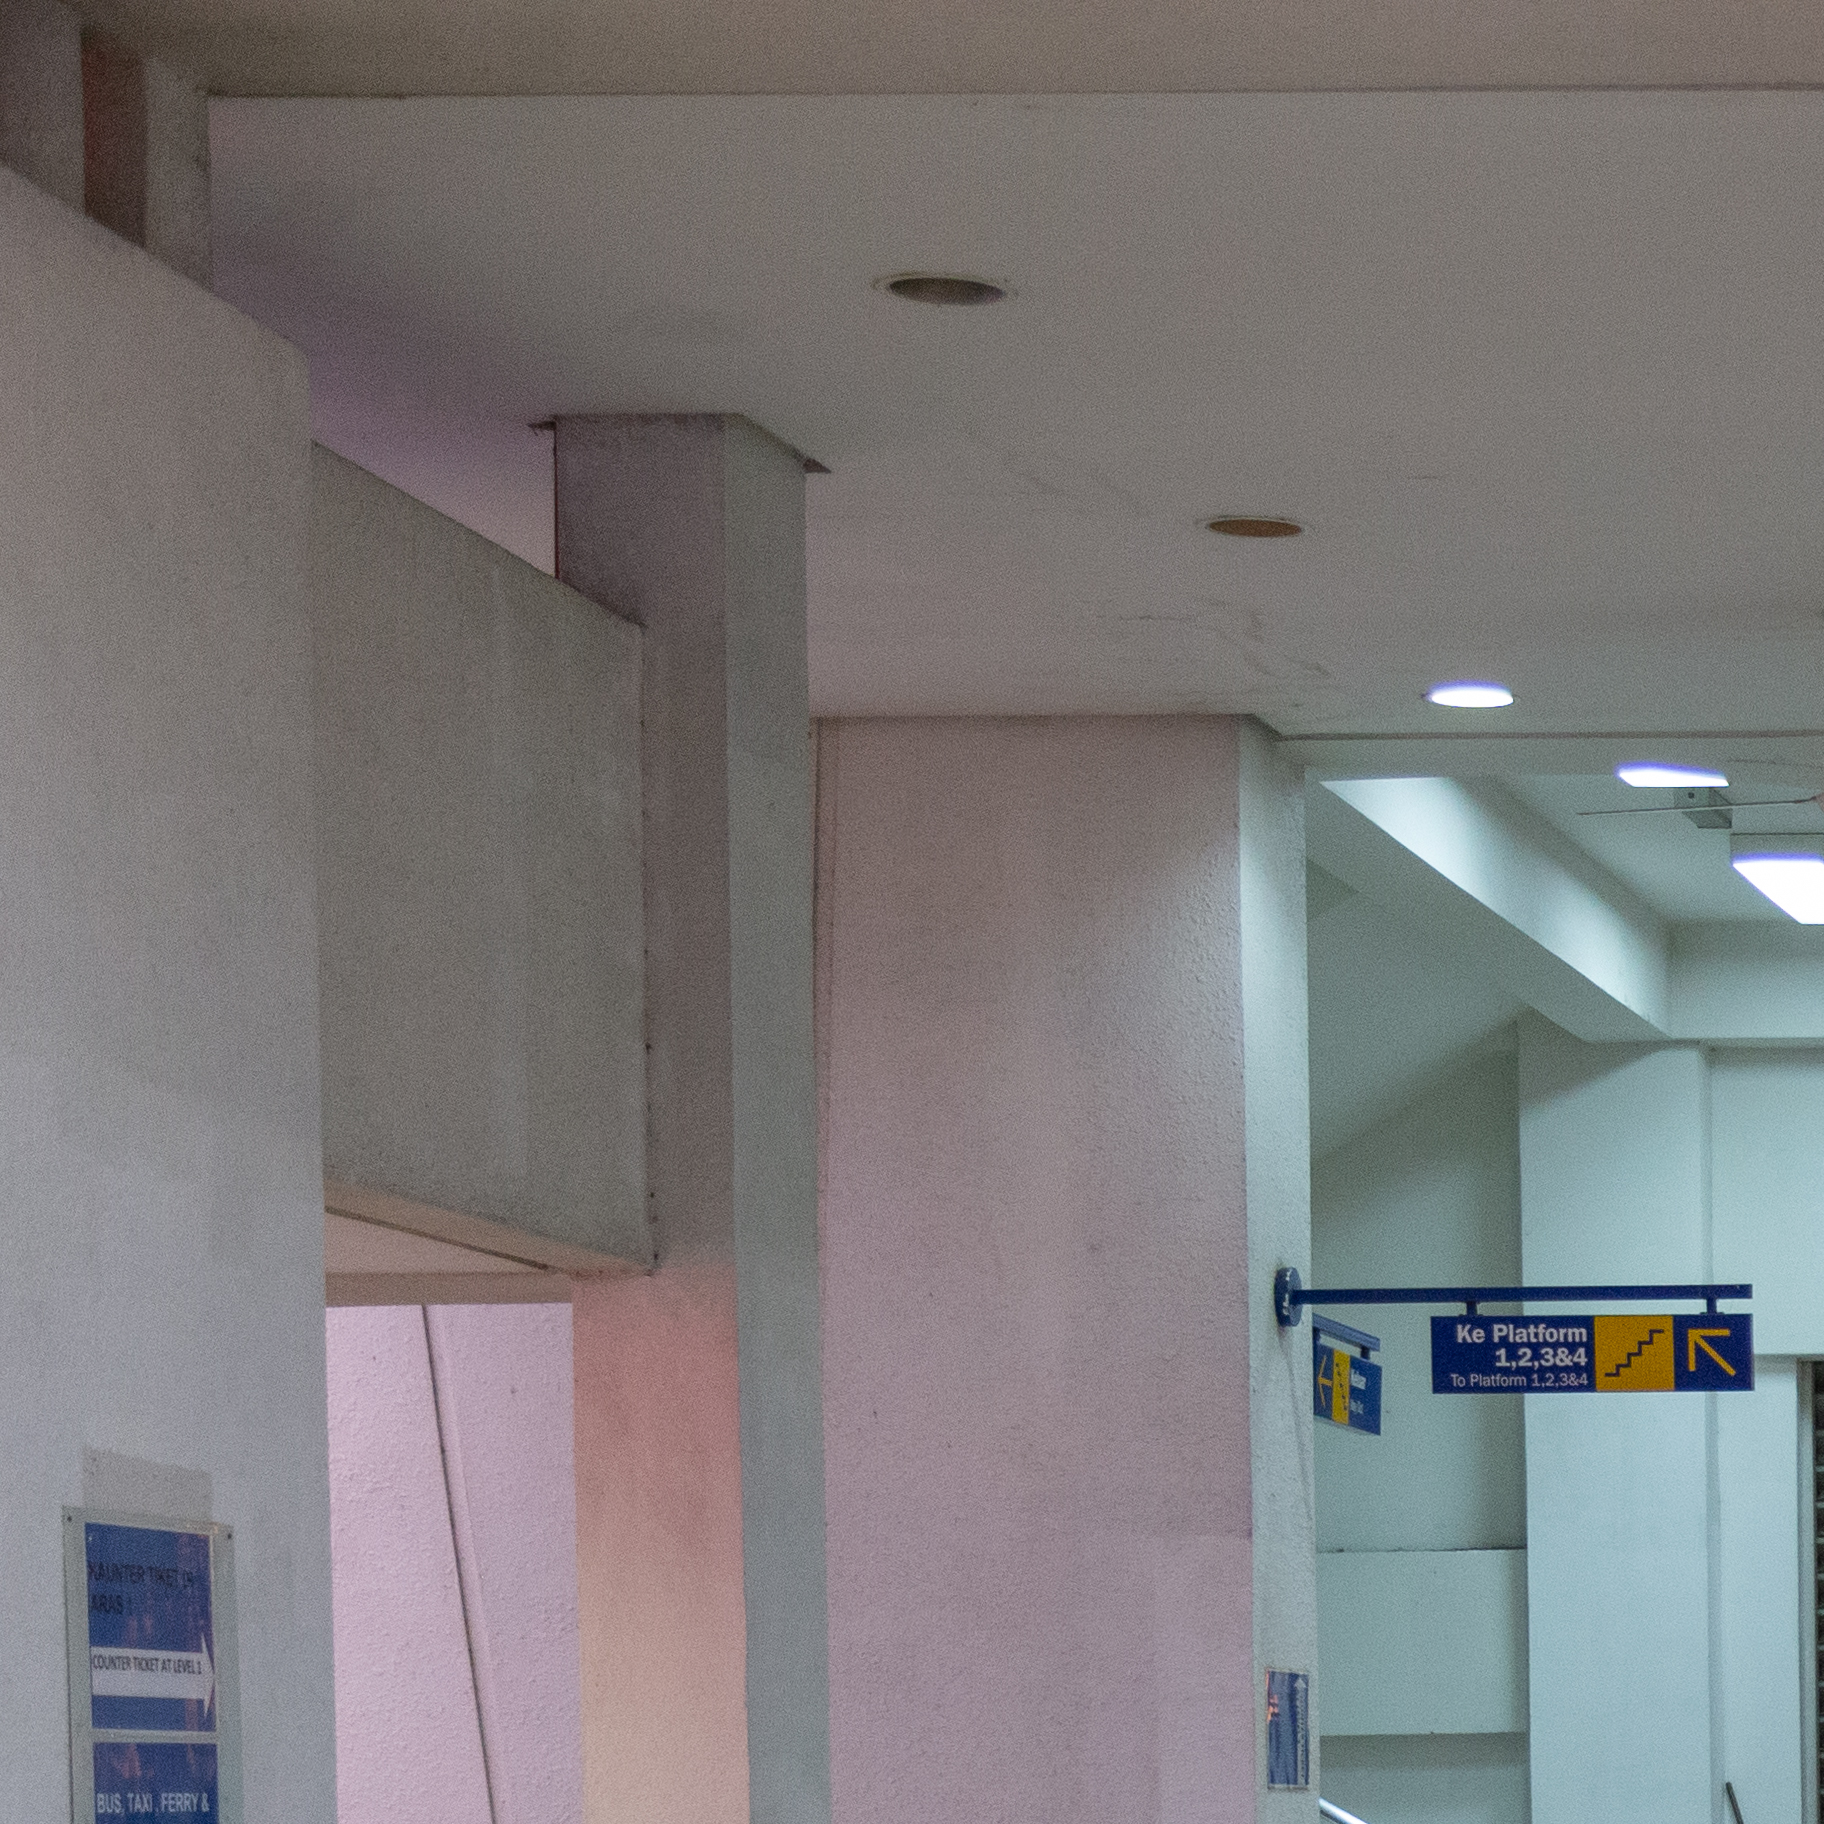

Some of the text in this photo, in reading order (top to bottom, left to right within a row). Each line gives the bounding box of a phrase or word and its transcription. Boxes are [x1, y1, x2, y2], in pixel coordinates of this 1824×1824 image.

[1456, 1323, 1588, 1343] Ke Platform
[1495, 1347, 1588, 1370] 1,2,3&4
[1450, 1373, 1588, 1388] To Platform 1,2,3&4
[93, 1655, 131, 1670] COUNTER
[133, 1657, 159, 1672] TICKET
[161, 1659, 174, 1673] AT
[174, 1659, 196, 1674] LEVEL
[161, 1792, 199, 1812] FERRY
[201, 1792, 209, 1812] &
